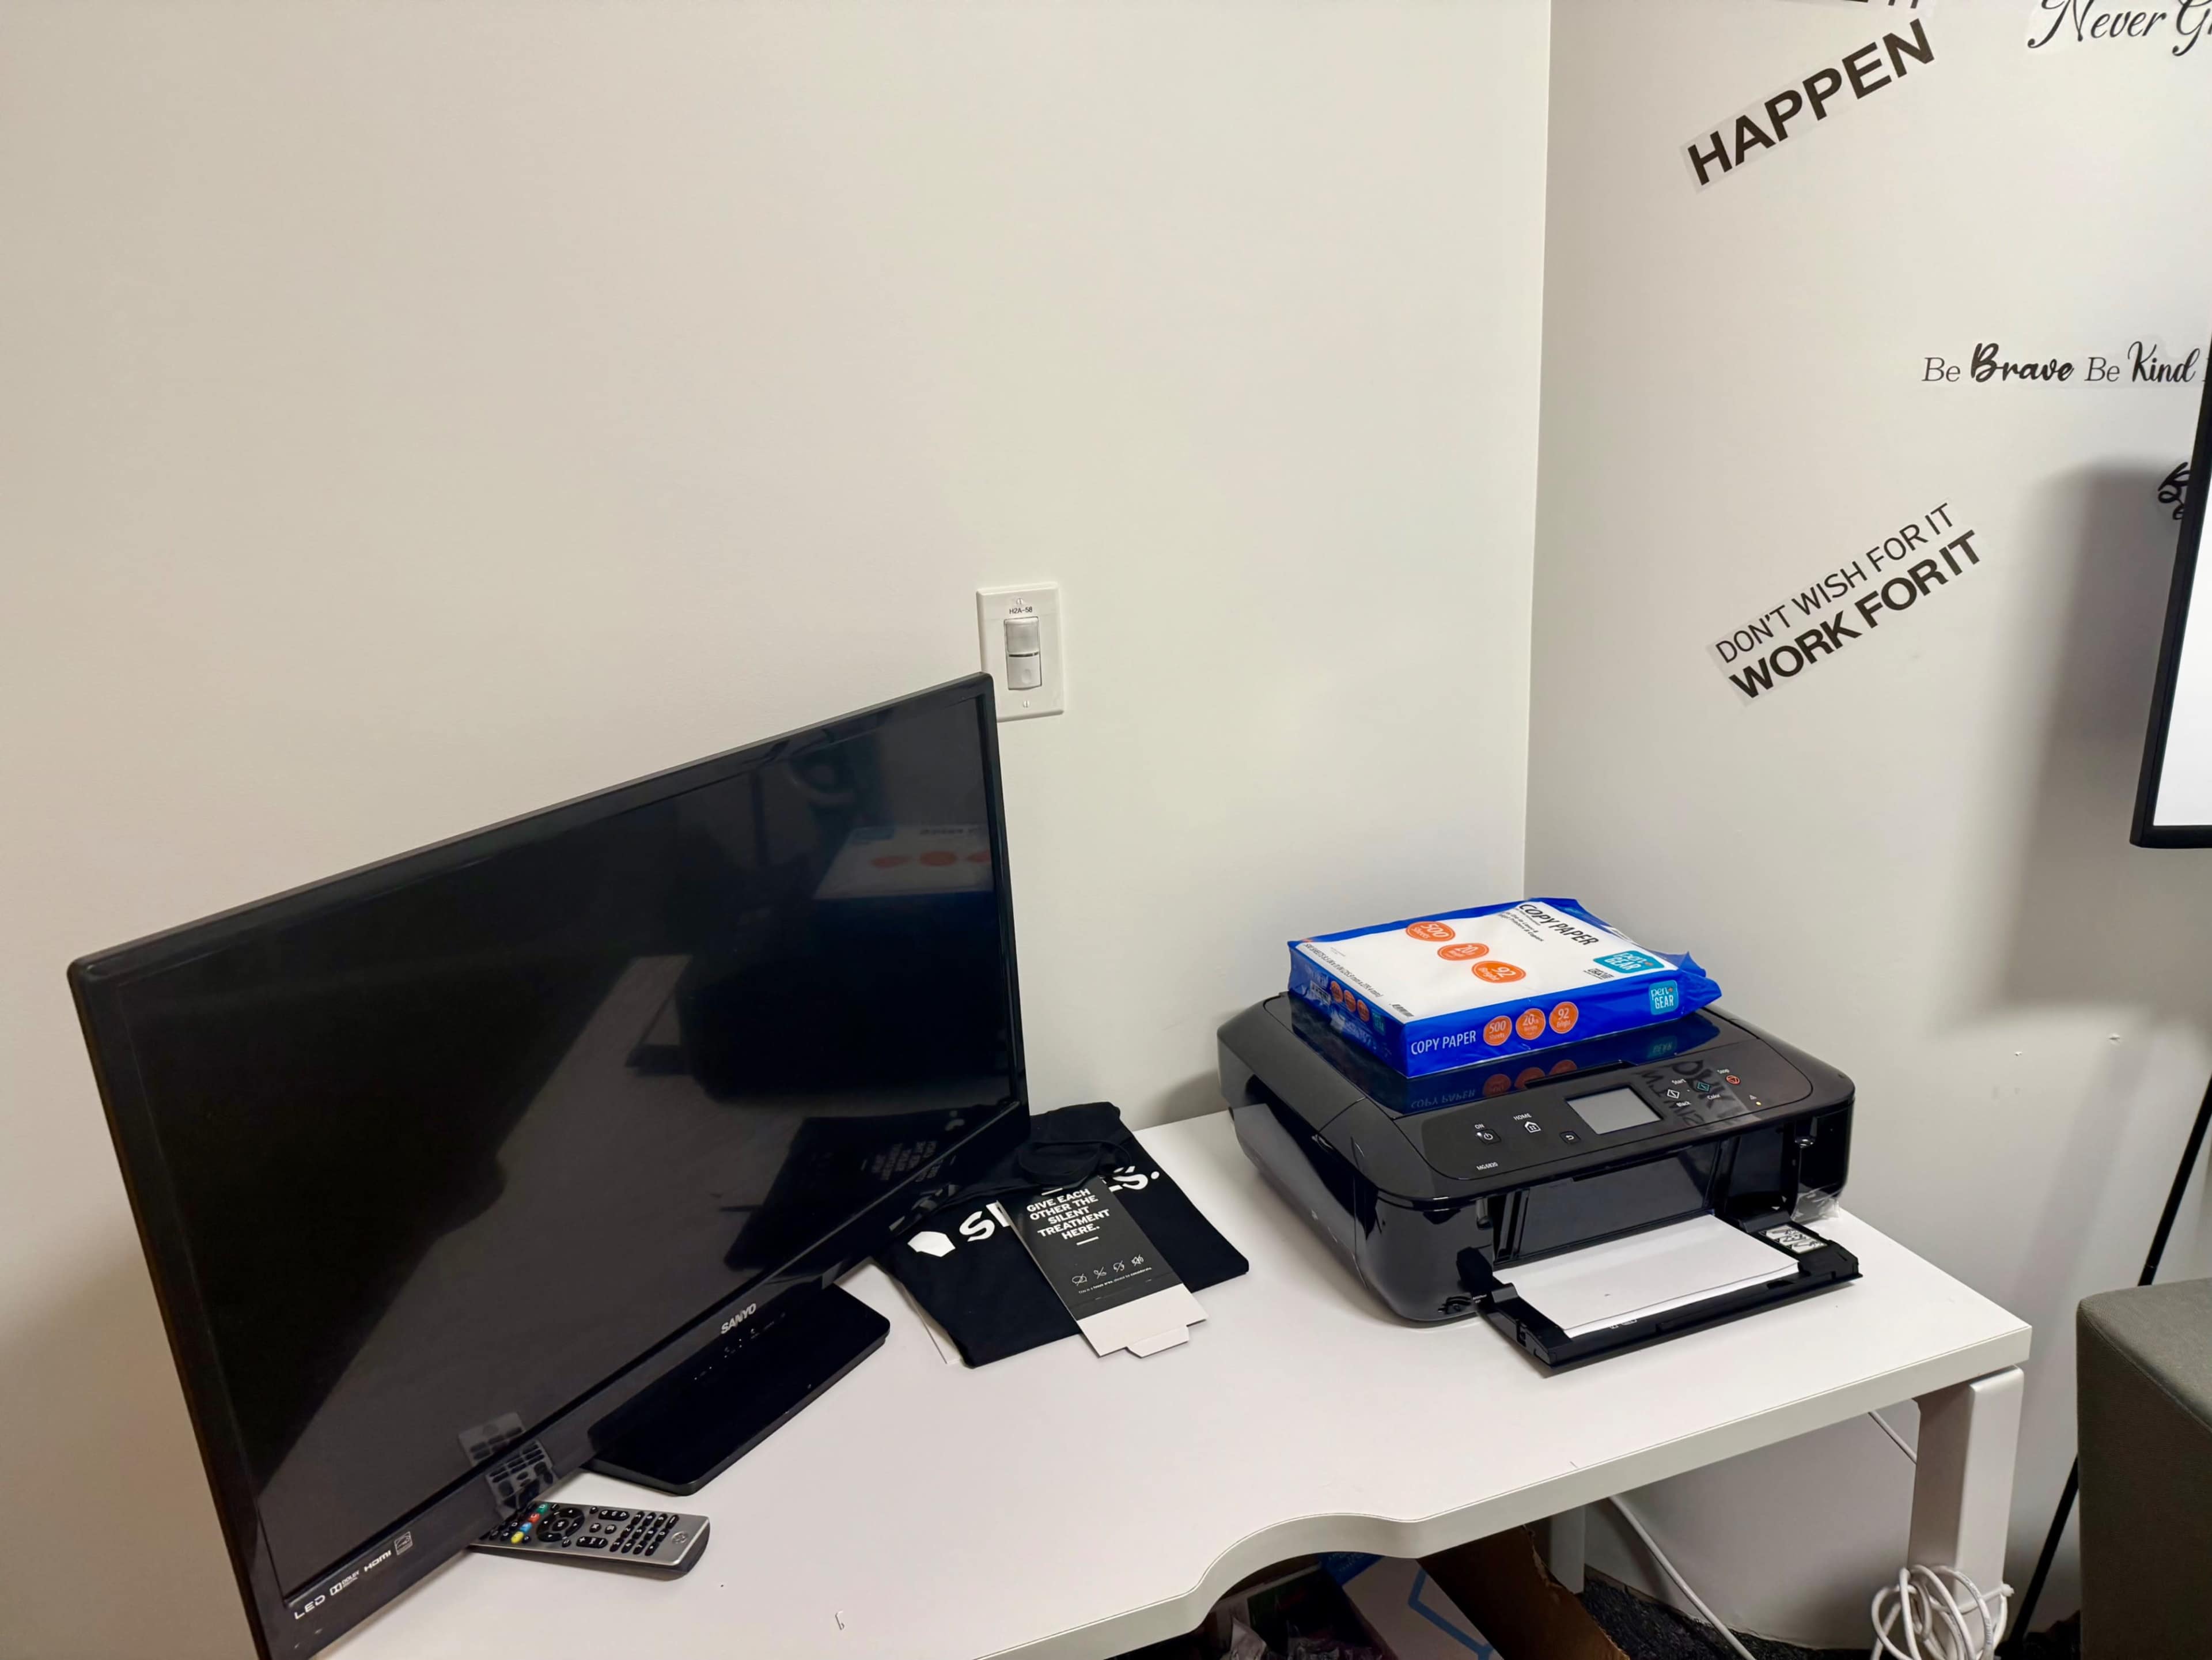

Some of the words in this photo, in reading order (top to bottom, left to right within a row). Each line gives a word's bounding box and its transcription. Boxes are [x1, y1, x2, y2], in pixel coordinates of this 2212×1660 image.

[2028, 0, 2166, 48] Never
[1687, 18, 1934, 186] HAPPEN
[1922, 356, 1961, 383] Be
[1970, 342, 2075, 384] Brave
[2084, 357, 2120, 383] Be
[2127, 341, 2200, 383] Kind
[1715, 605, 1792, 663] DON'T
[1791, 559, 1868, 617] WISH
[1866, 523, 1929, 573] FOR
[1925, 502, 1955, 536] IT
[1729, 610, 1863, 699] WORK
[1855, 558, 1949, 629] FOR
[1939, 530, 1982, 576] IT
[1421, 923, 1450, 938] 500
[1519, 904, 1559, 928] COPY
[1554, 923, 1599, 945] PAPER
[1492, 966, 1516, 978] 92
[1604, 957, 1642, 971] GEAR
[1558, 1008, 1569, 1019] 92
[1654, 995, 1674, 1009] GEAR
[1489, 1020, 1506, 1034] 500
[1411, 1038, 1440, 1054] COPY
[1442, 1030, 1476, 1049] PAPER
[1513, 1113, 1532, 1121] HOME
[1027, 1198, 1056, 1212] GIVE
[1057, 1189, 1091, 1203] EACH
[1029, 1203, 1071, 1220] OTHER
[1072, 1195, 1099, 1207] THE
[1037, 1209, 1110, 1237] TREATMENT
[1048, 1206, 1089, 1224] SILENT
[1061, 1223, 1100, 1239] HERE.
[721, 1303, 756, 1334] SANYO
[294, 1595, 325, 1620] LED
